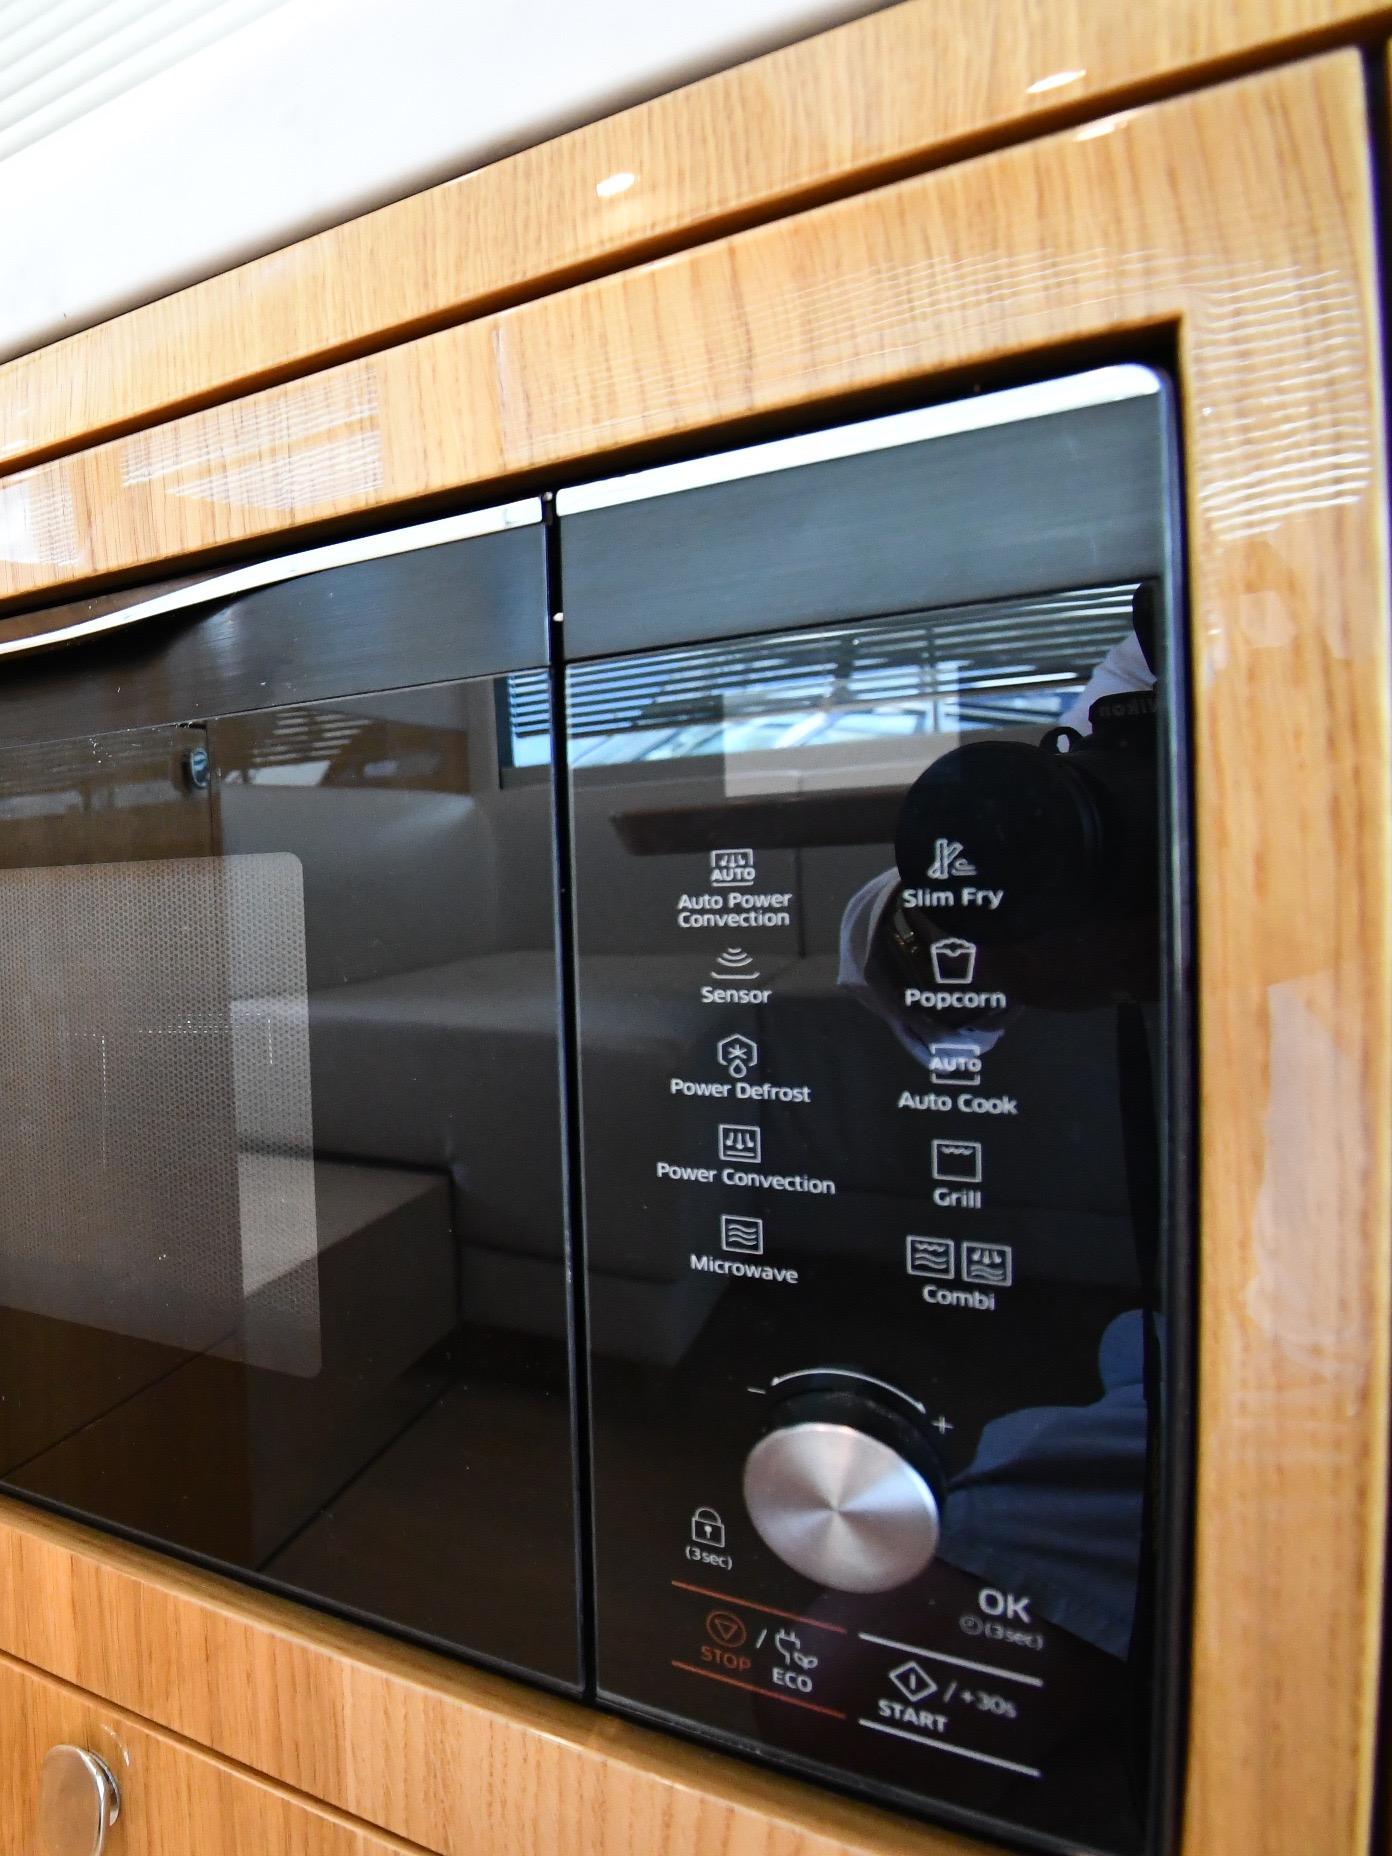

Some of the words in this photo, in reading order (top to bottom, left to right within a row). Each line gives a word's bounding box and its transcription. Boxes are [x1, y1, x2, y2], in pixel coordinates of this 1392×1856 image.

[711, 867, 755, 881] AUTO
[678, 894, 722, 910] Auto
[729, 891, 792, 909] Power
[903, 889, 954, 908] Slim
[961, 887, 1004, 910] Fry
[678, 911, 790, 928] Convection
[700, 986, 773, 1004] Sensor
[905, 989, 1007, 1010] Popcorn
[930, 1057, 982, 1073] AUTO
[671, 1079, 731, 1099] Power
[736, 1082, 811, 1102] Defrost
[898, 1091, 952, 1111] Auto
[957, 1093, 1018, 1115] Cook
[657, 1162, 717, 1184] Power
[722, 1168, 836, 1195] Convection
[933, 1187, 982, 1209] Grill
[690, 1253, 799, 1284] Microwave
[922, 1284, 995, 1311] Combi
[978, 1588, 1032, 1623] OK
[700, 1646, 751, 1671] STOP
[772, 1668, 813, 1693] ECO
[878, 1700, 948, 1733] START
